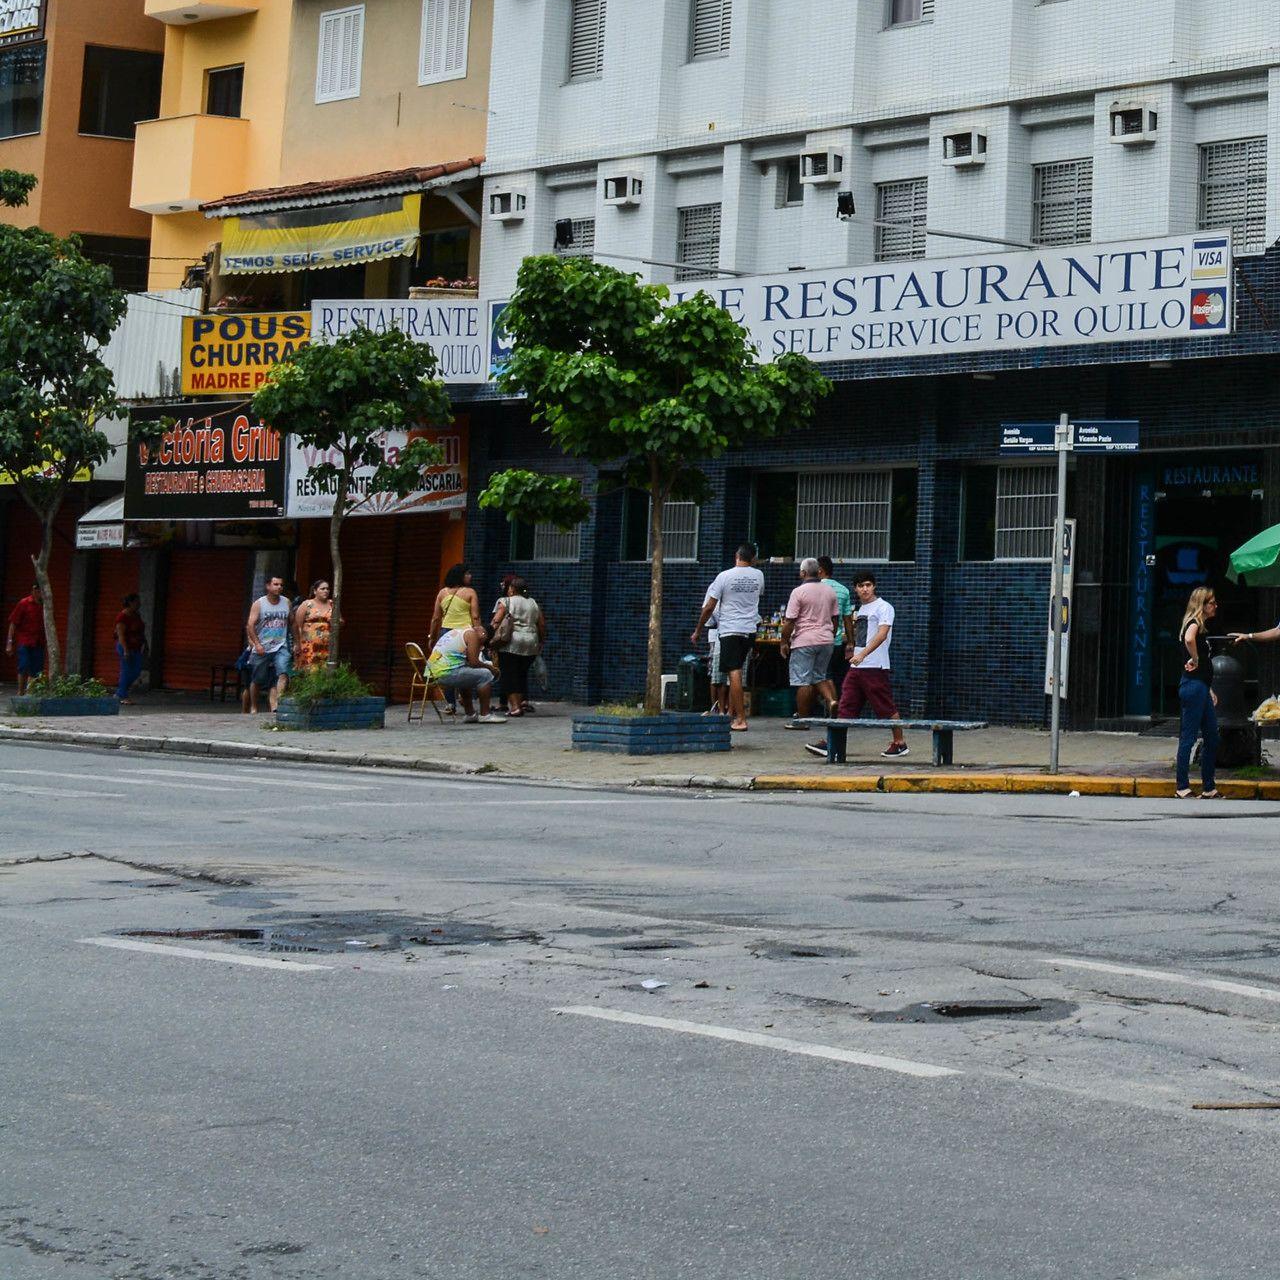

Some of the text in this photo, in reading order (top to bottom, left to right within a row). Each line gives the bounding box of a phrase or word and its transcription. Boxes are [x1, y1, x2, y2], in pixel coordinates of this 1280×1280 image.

[224, 256, 274, 269] TEMOS
[333, 238, 404, 260] SERVICE
[1199, 251, 1222, 266] VISA
[762, 247, 1187, 321] RESTAURANTE
[192, 315, 311, 342] POUS
[323, 307, 479, 337] RESTAURANTE
[772, 326, 841, 355] SELF
[851, 314, 982, 351] SERVICE
[995, 309, 1062, 341] POR
[1074, 299, 1186, 337] QUILO
[441, 344, 481, 377] QUILO
[191, 372, 250, 389] MADRE
[1164, 465, 1258, 485] RESTAURANTE
[1135, 485, 1150, 686] RESTAURANTE
